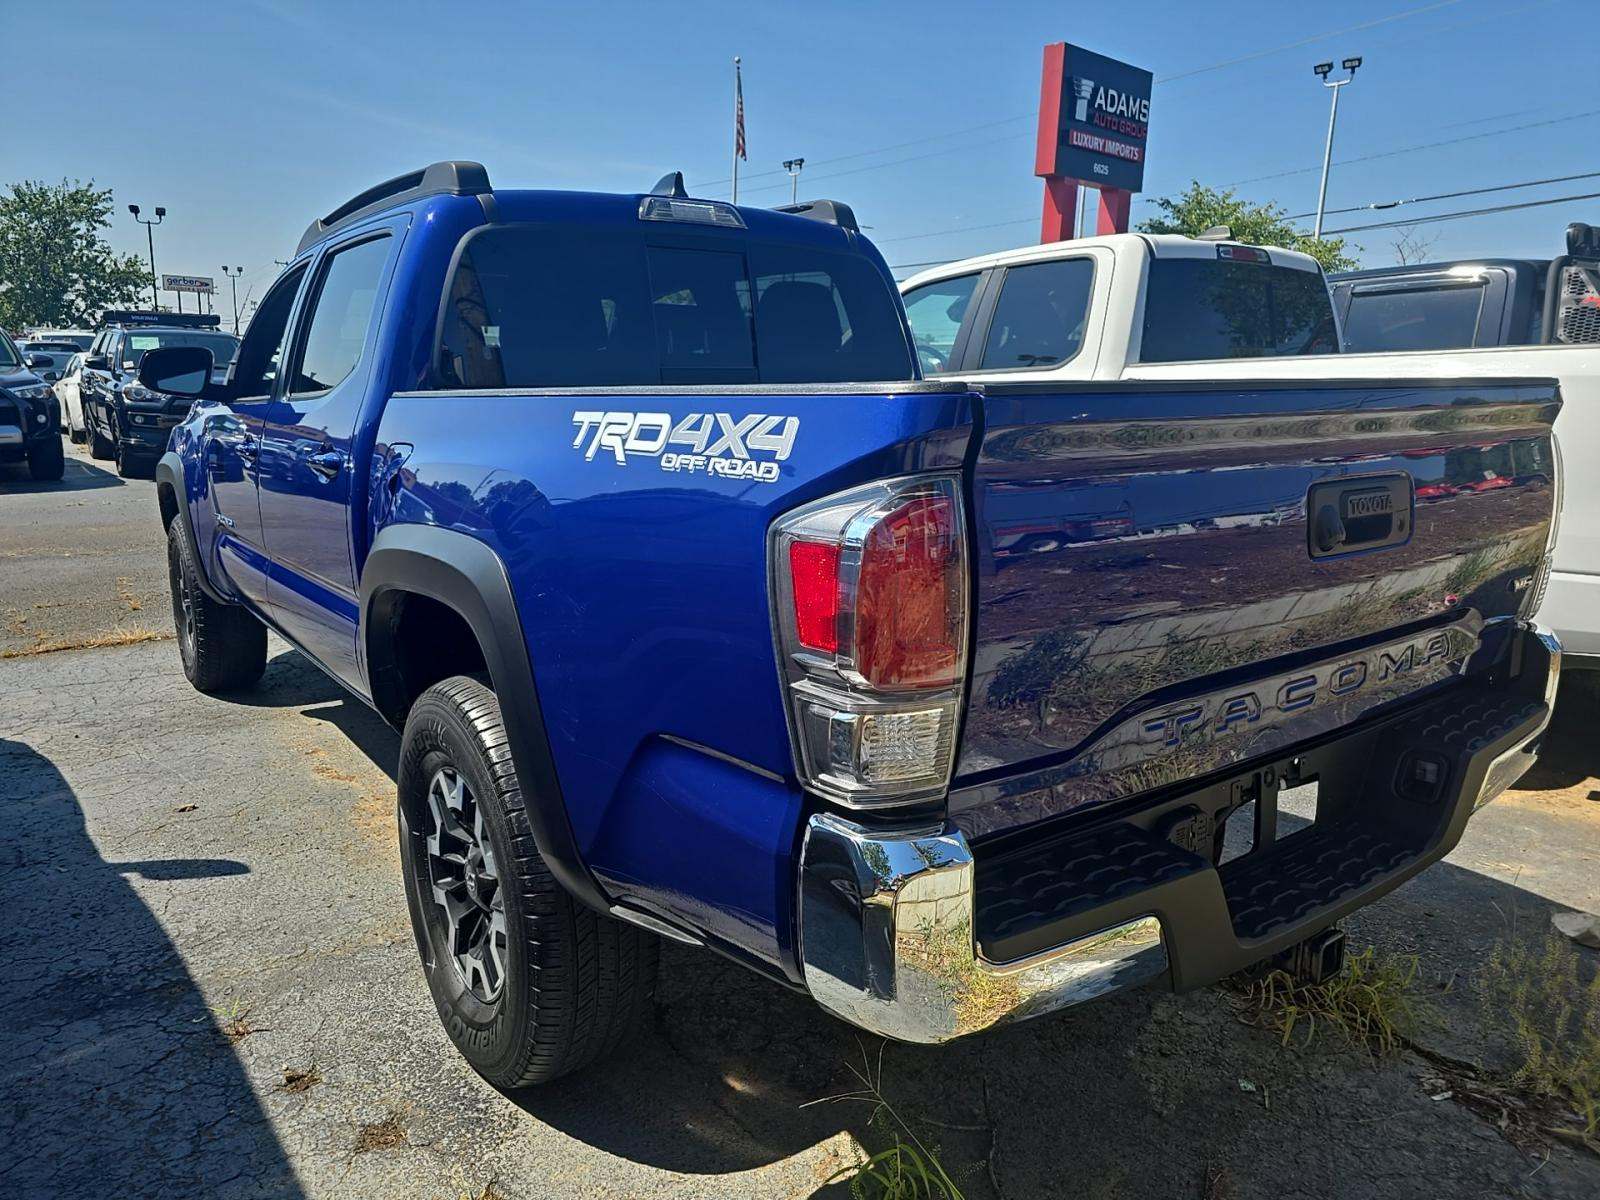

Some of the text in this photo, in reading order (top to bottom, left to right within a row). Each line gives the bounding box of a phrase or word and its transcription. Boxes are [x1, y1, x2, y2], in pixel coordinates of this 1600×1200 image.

[1094, 86, 1150, 122] ADAMS
[1093, 111, 1119, 131] AUTO
[1072, 131, 1139, 161] LUXURY IMPORTS
[572, 411, 672, 466] TRD
[660, 453, 781, 483] OFF ROAD
[1349, 494, 1393, 515] TOYOTA
[1142, 632, 1452, 747] TACOMA
